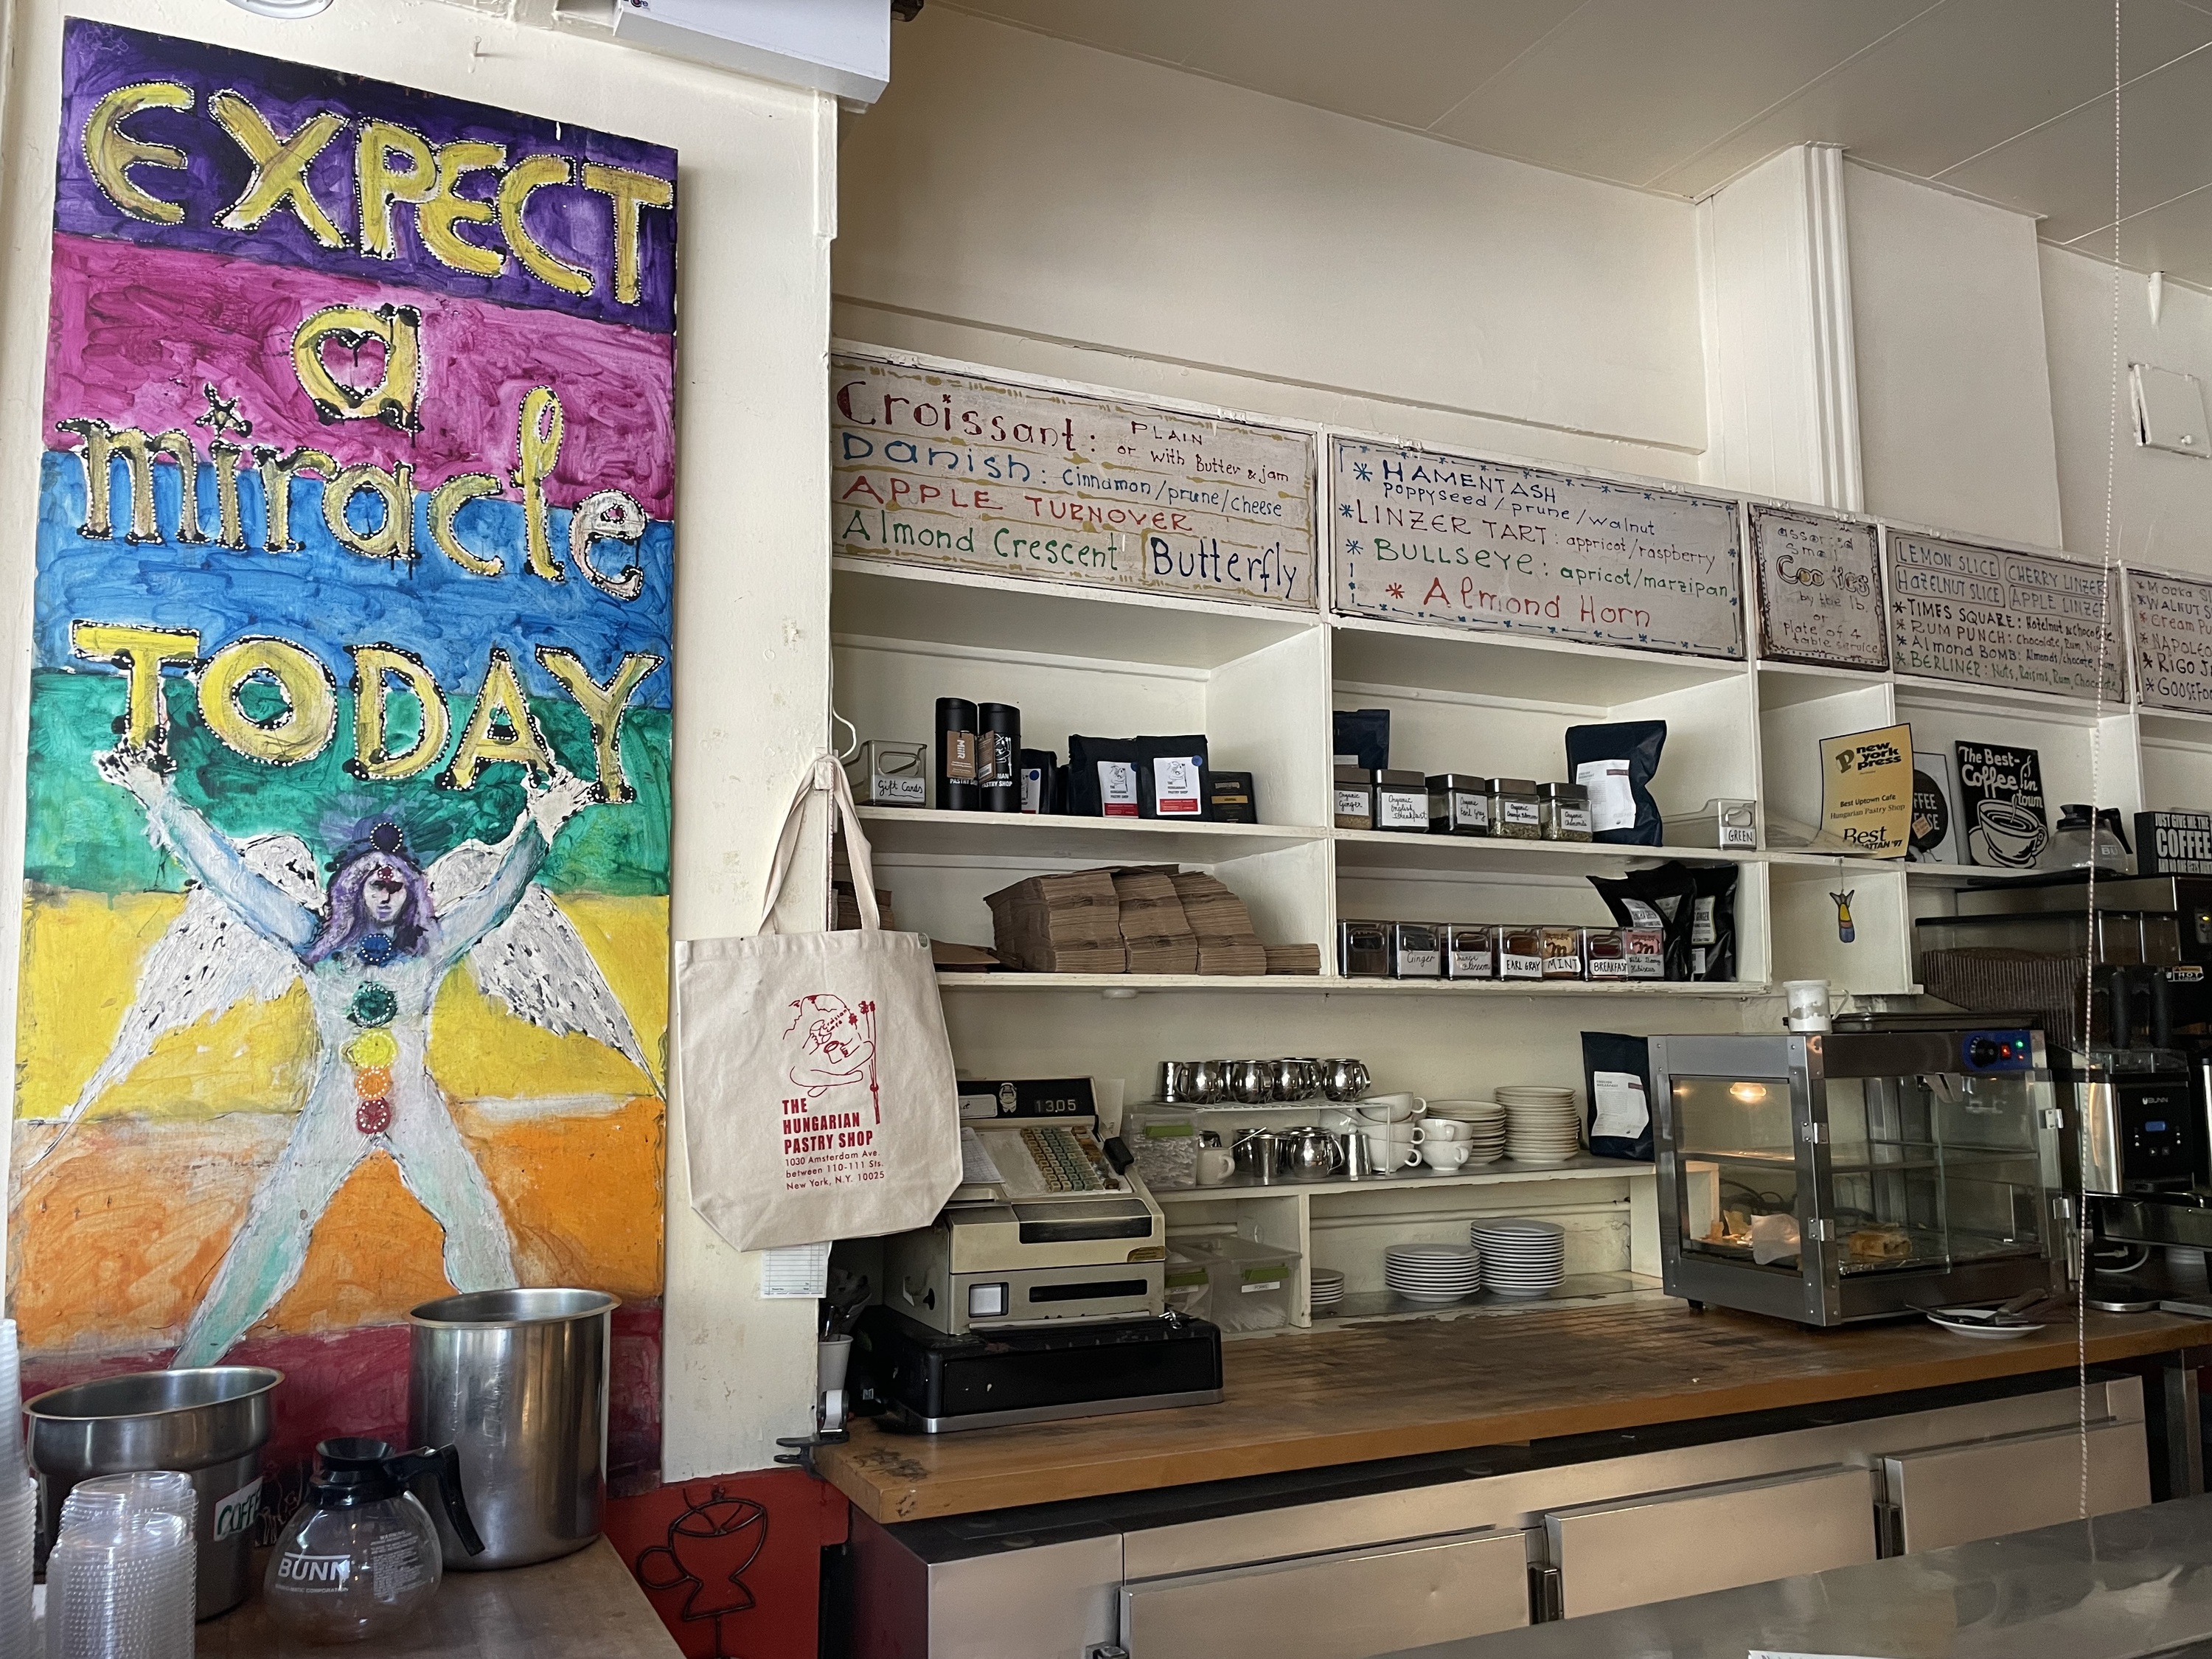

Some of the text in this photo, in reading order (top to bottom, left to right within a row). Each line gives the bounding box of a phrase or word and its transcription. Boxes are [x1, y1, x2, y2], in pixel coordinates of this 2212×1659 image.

[83, 79, 674, 305] EXPECT
[292, 304, 423, 435] a
[837, 380, 1096, 453] Croissant:
[1131, 420, 1203, 445] PLAIN
[842, 431, 1047, 485] Danish:
[1116, 444, 1136, 456] or
[1150, 446, 1185, 467] with
[1195, 453, 1241, 476] Butter
[57, 385, 649, 600] miracle
[842, 475, 1194, 532] APPLE TURNOVER
[1357, 498, 1471, 536] LINZER
[842, 509, 1298, 599] Almond Crescent Butterfly
[1898, 540, 1997, 577] LEMON SLICE
[2008, 565, 2107, 596] CHERRY LINZER
[1423, 576, 1651, 628] Almond Horn
[1800, 591, 1814, 608] by
[1969, 582, 2000, 604] SLICE
[2011, 588, 2057, 610] APPLE
[1907, 597, 1952, 620] TIMES
[2146, 594, 2200, 616] WALNUT
[1812, 613, 1828, 623] or
[1826, 625, 1843, 639] of
[1911, 620, 1951, 637] RUM
[1792, 632, 1832, 648] table
[1912, 637, 1974, 657] Almond
[72, 620, 664, 804] TODAY
[1856, 741, 1891, 754] new
[1861, 746, 1899, 763] york
[1958, 745, 1983, 764] The
[1857, 754, 1902, 771] press
[877, 779, 924, 797] Gift Cards
[1961, 763, 2020, 799] Coffee
[2023, 772, 2038, 792] in
[1388, 794, 1413, 805] Organic
[1840, 800, 1854, 808] Best
[1854, 796, 1880, 807] Uptown
[2017, 789, 2044, 809] town
[1830, 803, 1906, 820] Hungarian Pastry Shop
[1728, 829, 1753, 844] GREEN
[1843, 826, 1888, 846] Best
[2156, 828, 2212, 860] COFFEE
[1406, 950, 1436, 968] Ginger
[1506, 959, 1541, 972] EARL GRAY
[1548, 958, 1578, 970] MINT
[1593, 961, 1628, 973] BREAKFAST
[782, 1098, 808, 1115] THE
[782, 1112, 860, 1135] HUNGARIAN
[784, 1130, 874, 1155] PASTRY SHOP
[785, 1149, 881, 1167] 1030 Amsterdam Ave.
[786, 1166, 823, 1178] between
[827, 1161, 866, 1173] 110-111
[786, 1171, 886, 1191] New York, N.Y. 10025
[277, 1557, 351, 1582] BUNN
